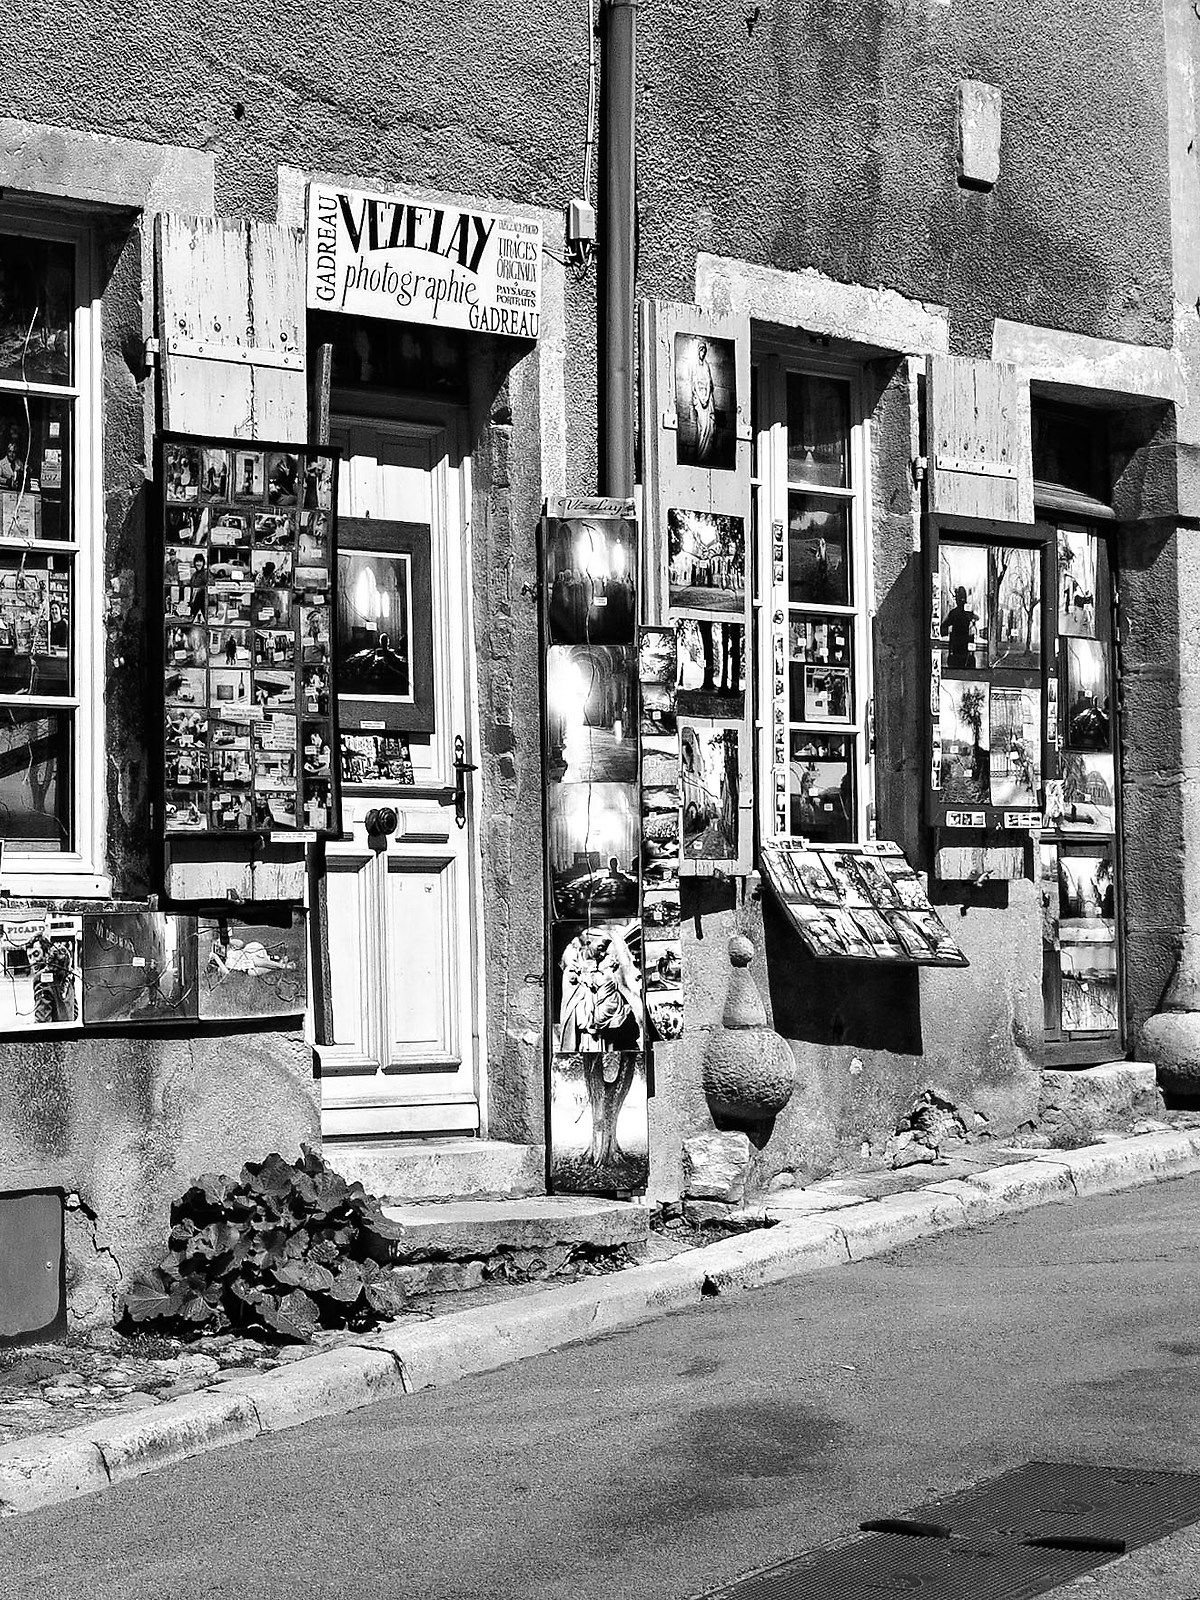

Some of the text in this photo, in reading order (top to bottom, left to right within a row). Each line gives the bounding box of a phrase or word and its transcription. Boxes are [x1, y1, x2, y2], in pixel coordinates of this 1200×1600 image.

[316, 196, 337, 301] GADREAU
[336, 193, 496, 275] VEZELAY
[498, 236, 538, 262] TIRAGES
[341, 256, 480, 319] photographie
[496, 284, 537, 298] PAYSAGES
[496, 295, 537, 308] PORTRAITS
[469, 304, 540, 338] GADREAU
[7, 925, 46, 934] PICARD
